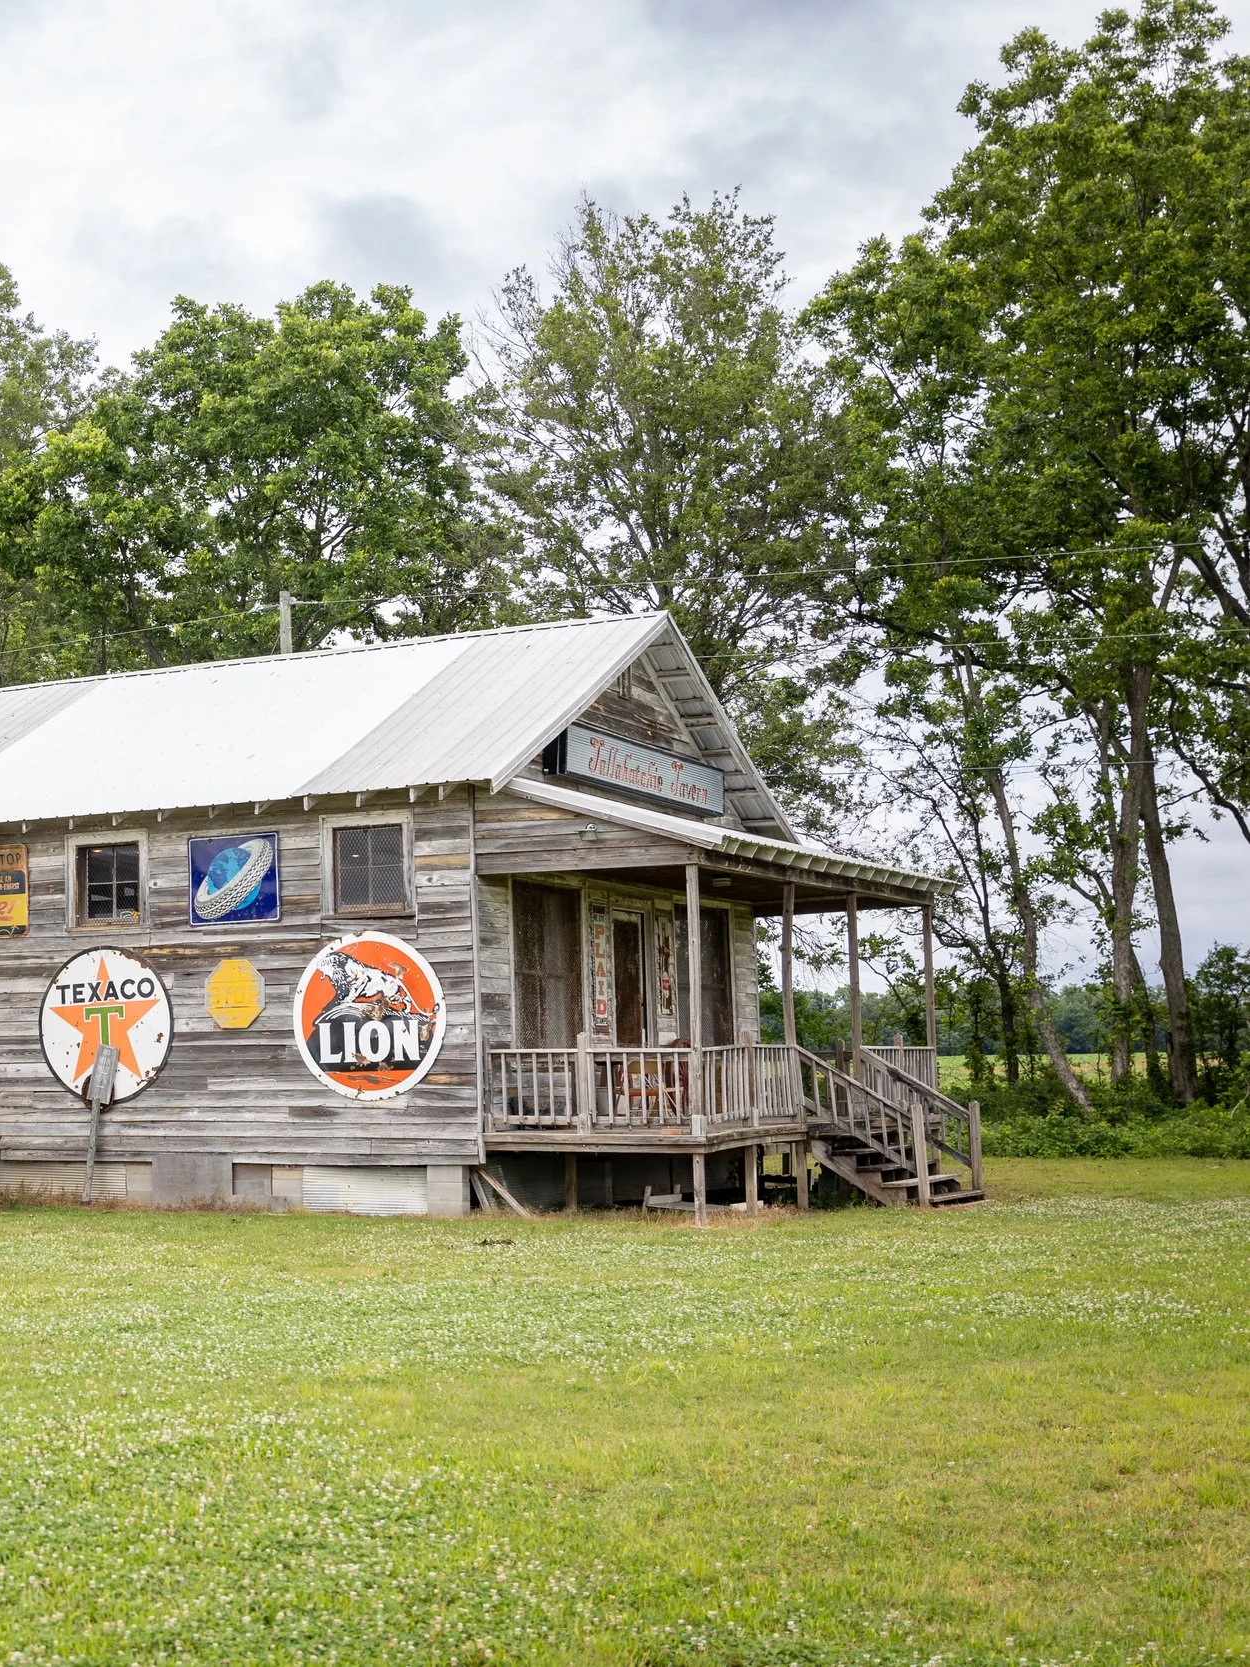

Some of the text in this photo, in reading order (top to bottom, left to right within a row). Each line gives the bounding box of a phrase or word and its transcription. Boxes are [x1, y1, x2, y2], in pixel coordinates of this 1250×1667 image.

[588, 736, 708, 804] Tallahatchie Tavern
[55, 977, 155, 1005] TEXACO
[593, 923, 608, 1016] PLAID
[318, 1020, 421, 1063] LION
